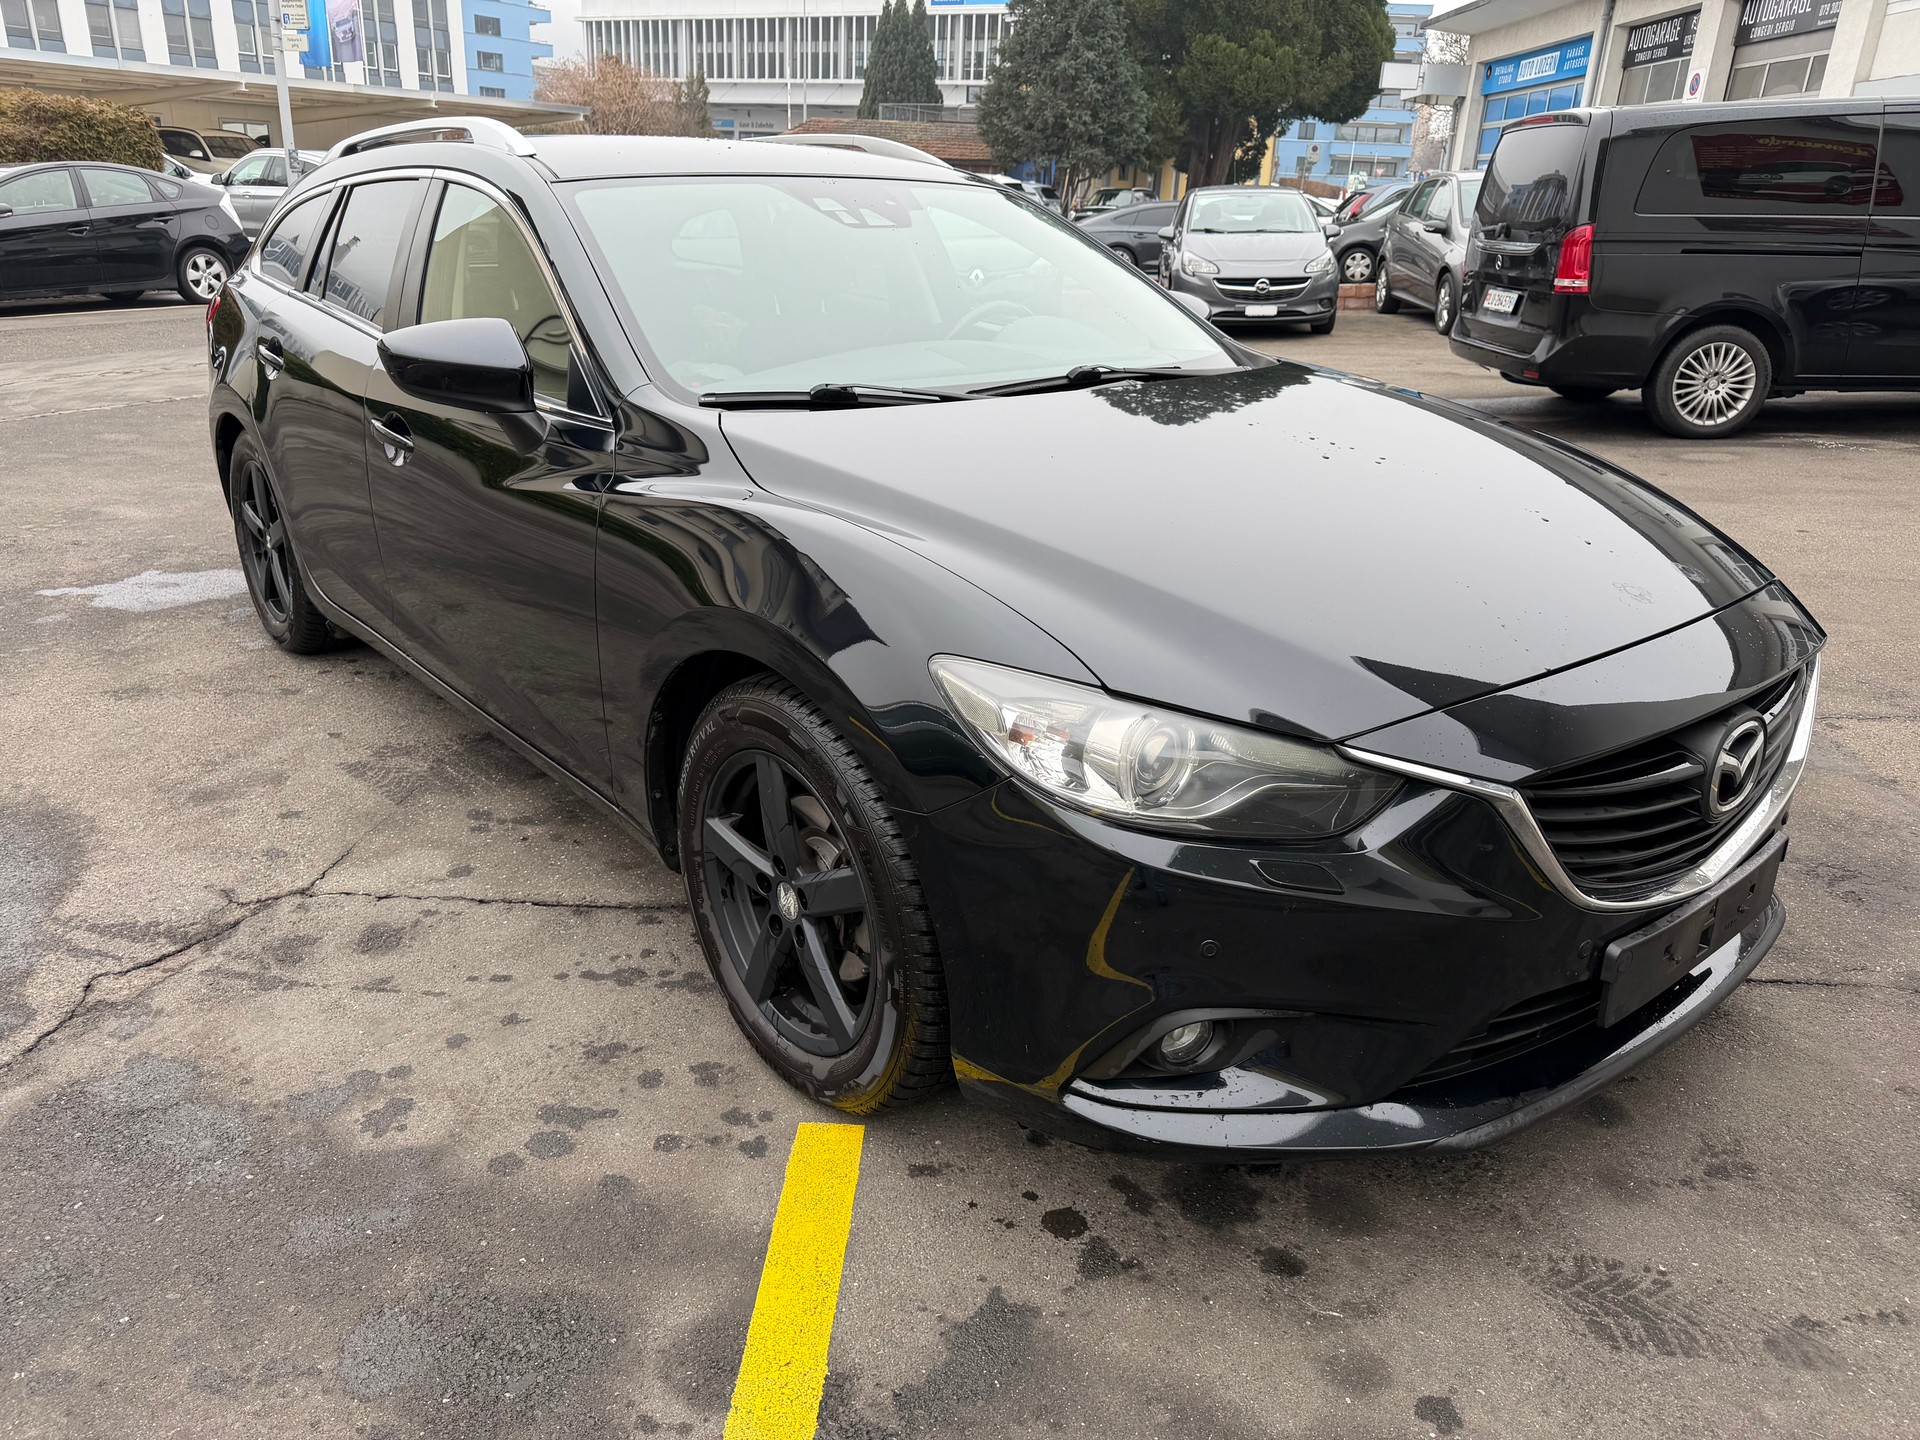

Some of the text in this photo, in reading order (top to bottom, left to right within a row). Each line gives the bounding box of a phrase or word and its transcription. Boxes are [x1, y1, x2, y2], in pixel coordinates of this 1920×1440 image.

[1627, 17, 1683, 52] AUTOGARAGE
[1750, 19, 1796, 38] CONGEDI SERGIO
[1566, 45, 1585, 59] GARAGE
[1634, 50, 1652, 62] CONGEDI
[1652, 47, 1668, 59] SERGIO
[1519, 54, 1559, 79] AUTO LUZERN
[1498, 74, 1512, 85] STUDIO
[689, 735, 700, 757] R17
[700, 728, 705, 740] V
[705, 721, 716, 736] XL
